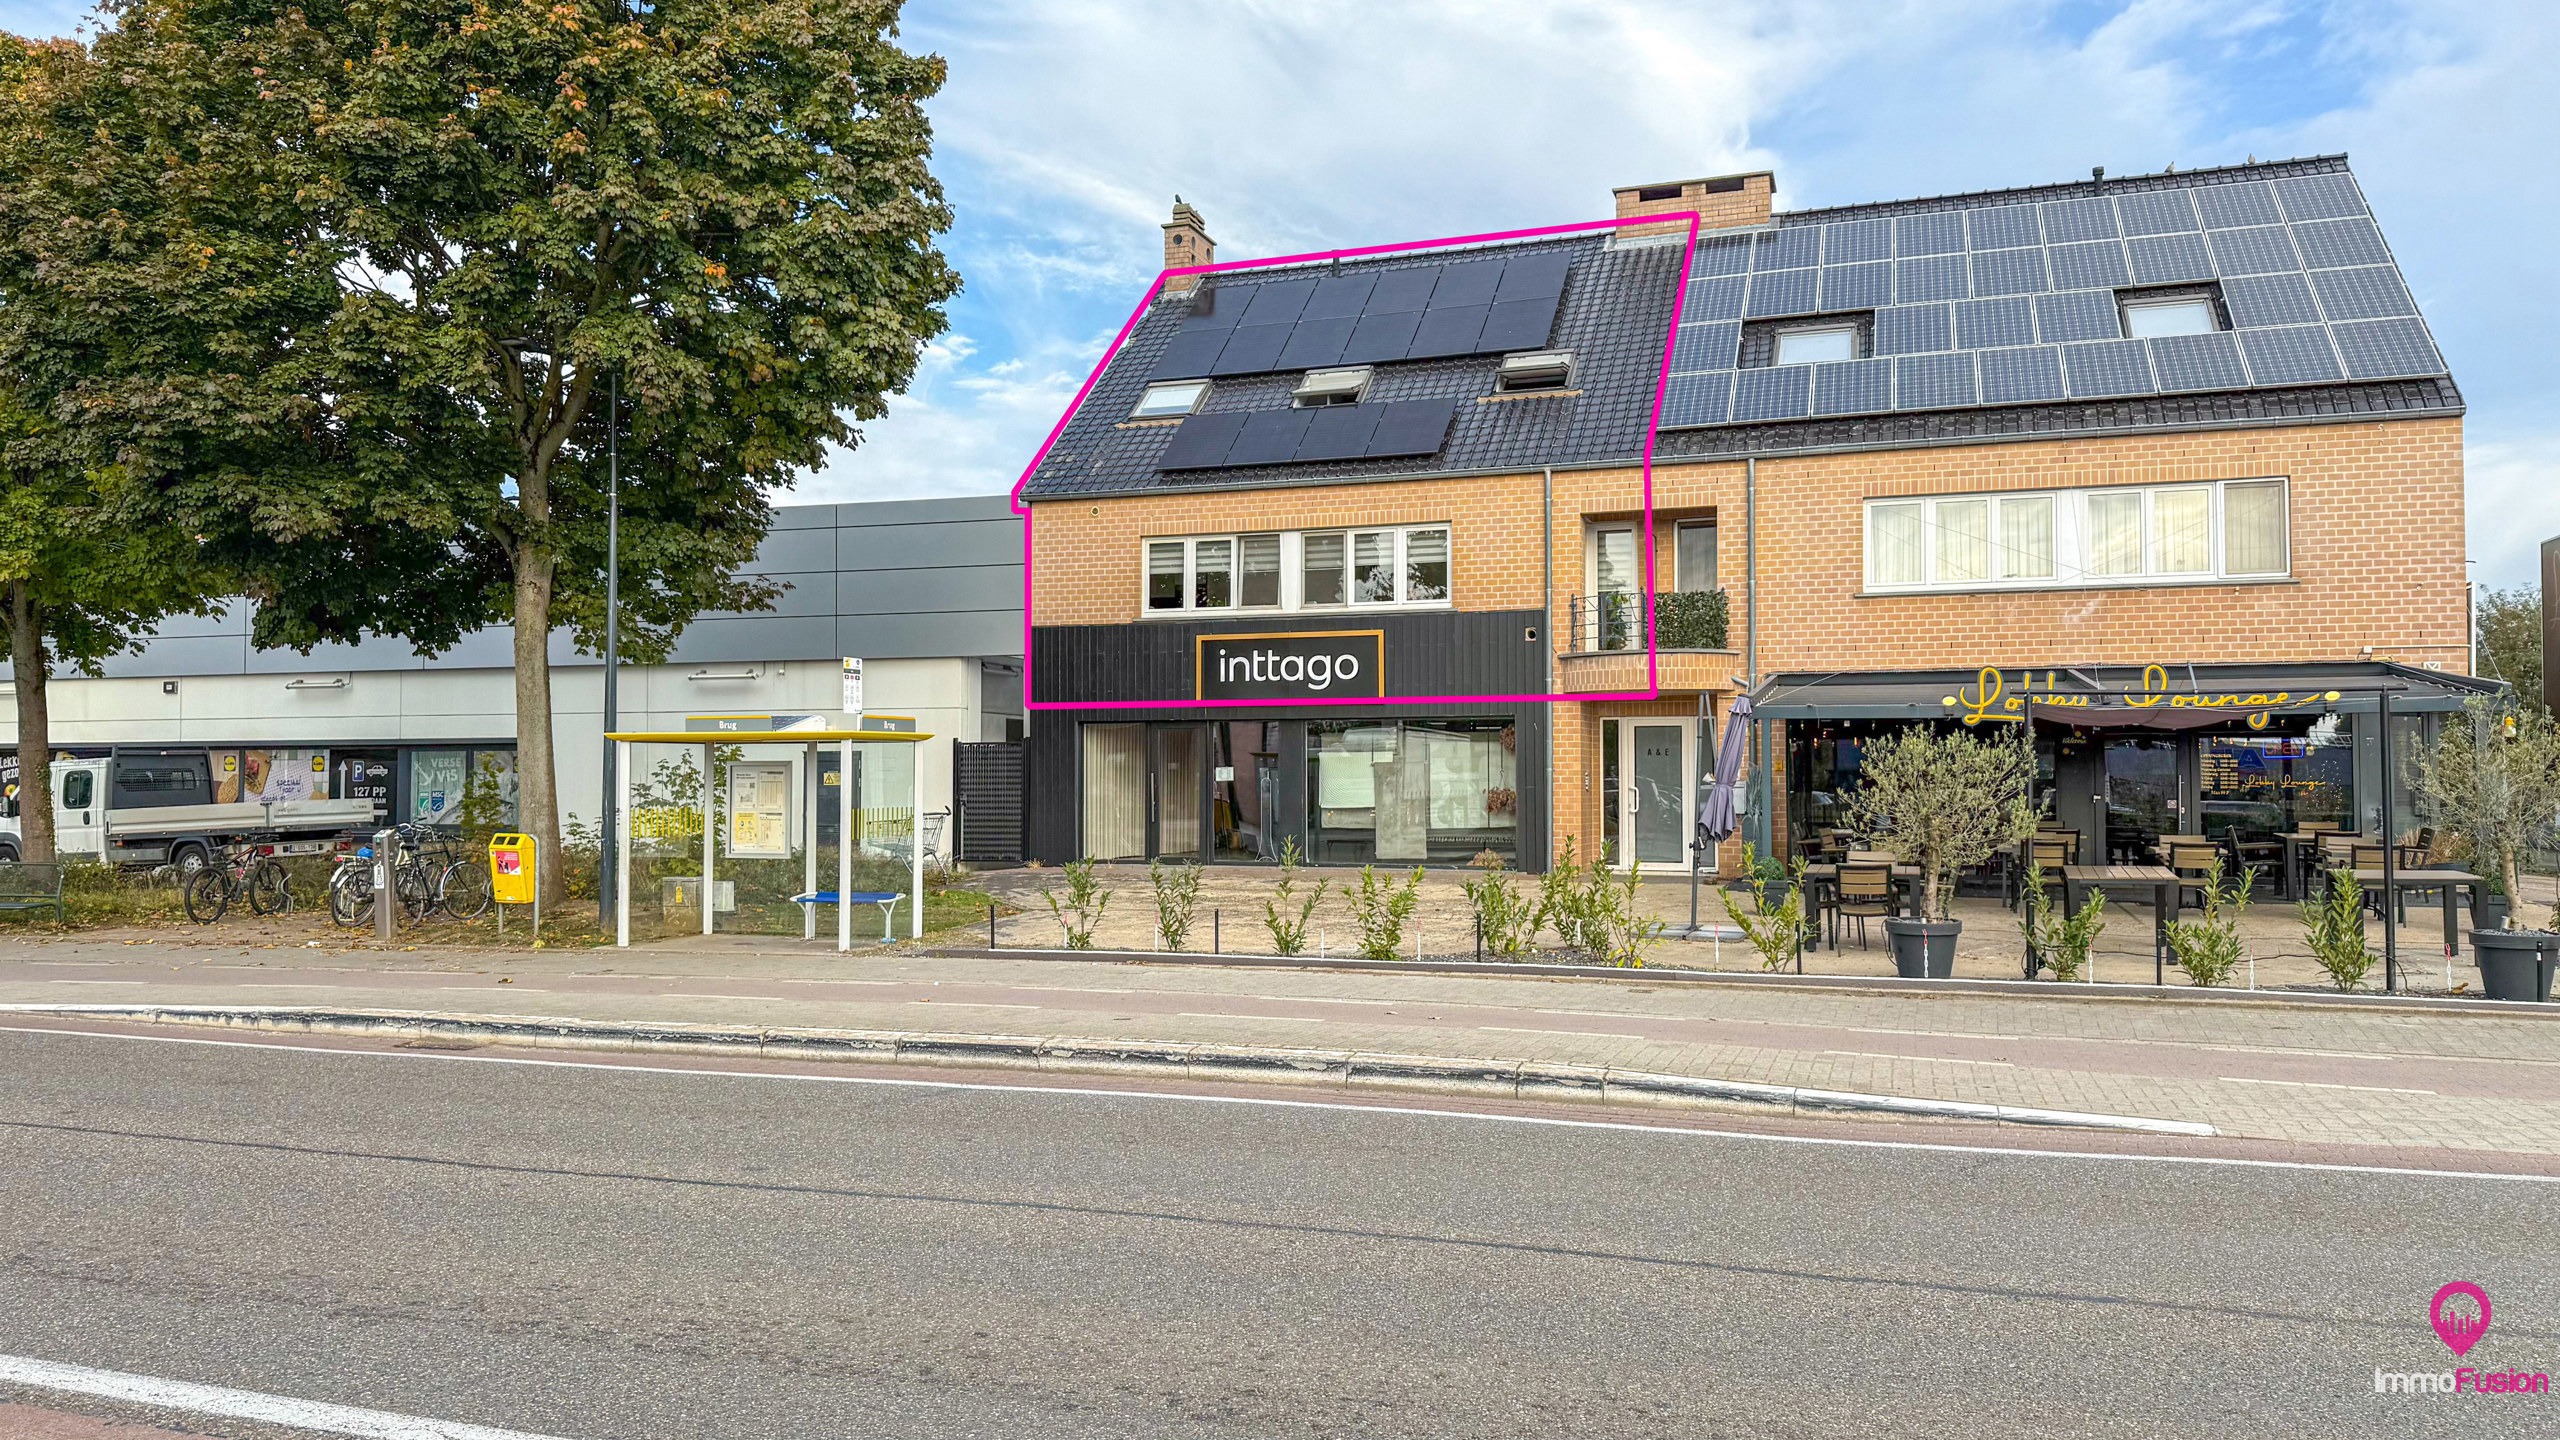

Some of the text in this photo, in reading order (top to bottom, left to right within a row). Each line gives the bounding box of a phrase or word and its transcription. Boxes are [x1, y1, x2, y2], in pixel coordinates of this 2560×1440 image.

[1219, 648, 1360, 691] inttago
[1959, 664, 2321, 730] Lobby Lounge
[719, 720, 737, 731] Brug
[1647, 747, 1670, 757] A & E
[0, 756, 19, 769] Lekk
[431, 757, 461, 768] VERSE
[1, 768, 19, 783] gezo
[354, 764, 363, 778] P
[436, 769, 458, 782] VIS
[2244, 774, 2275, 791] Lobby
[2280, 774, 2326, 791] Lounge
[353, 786, 387, 797] 127 PP
